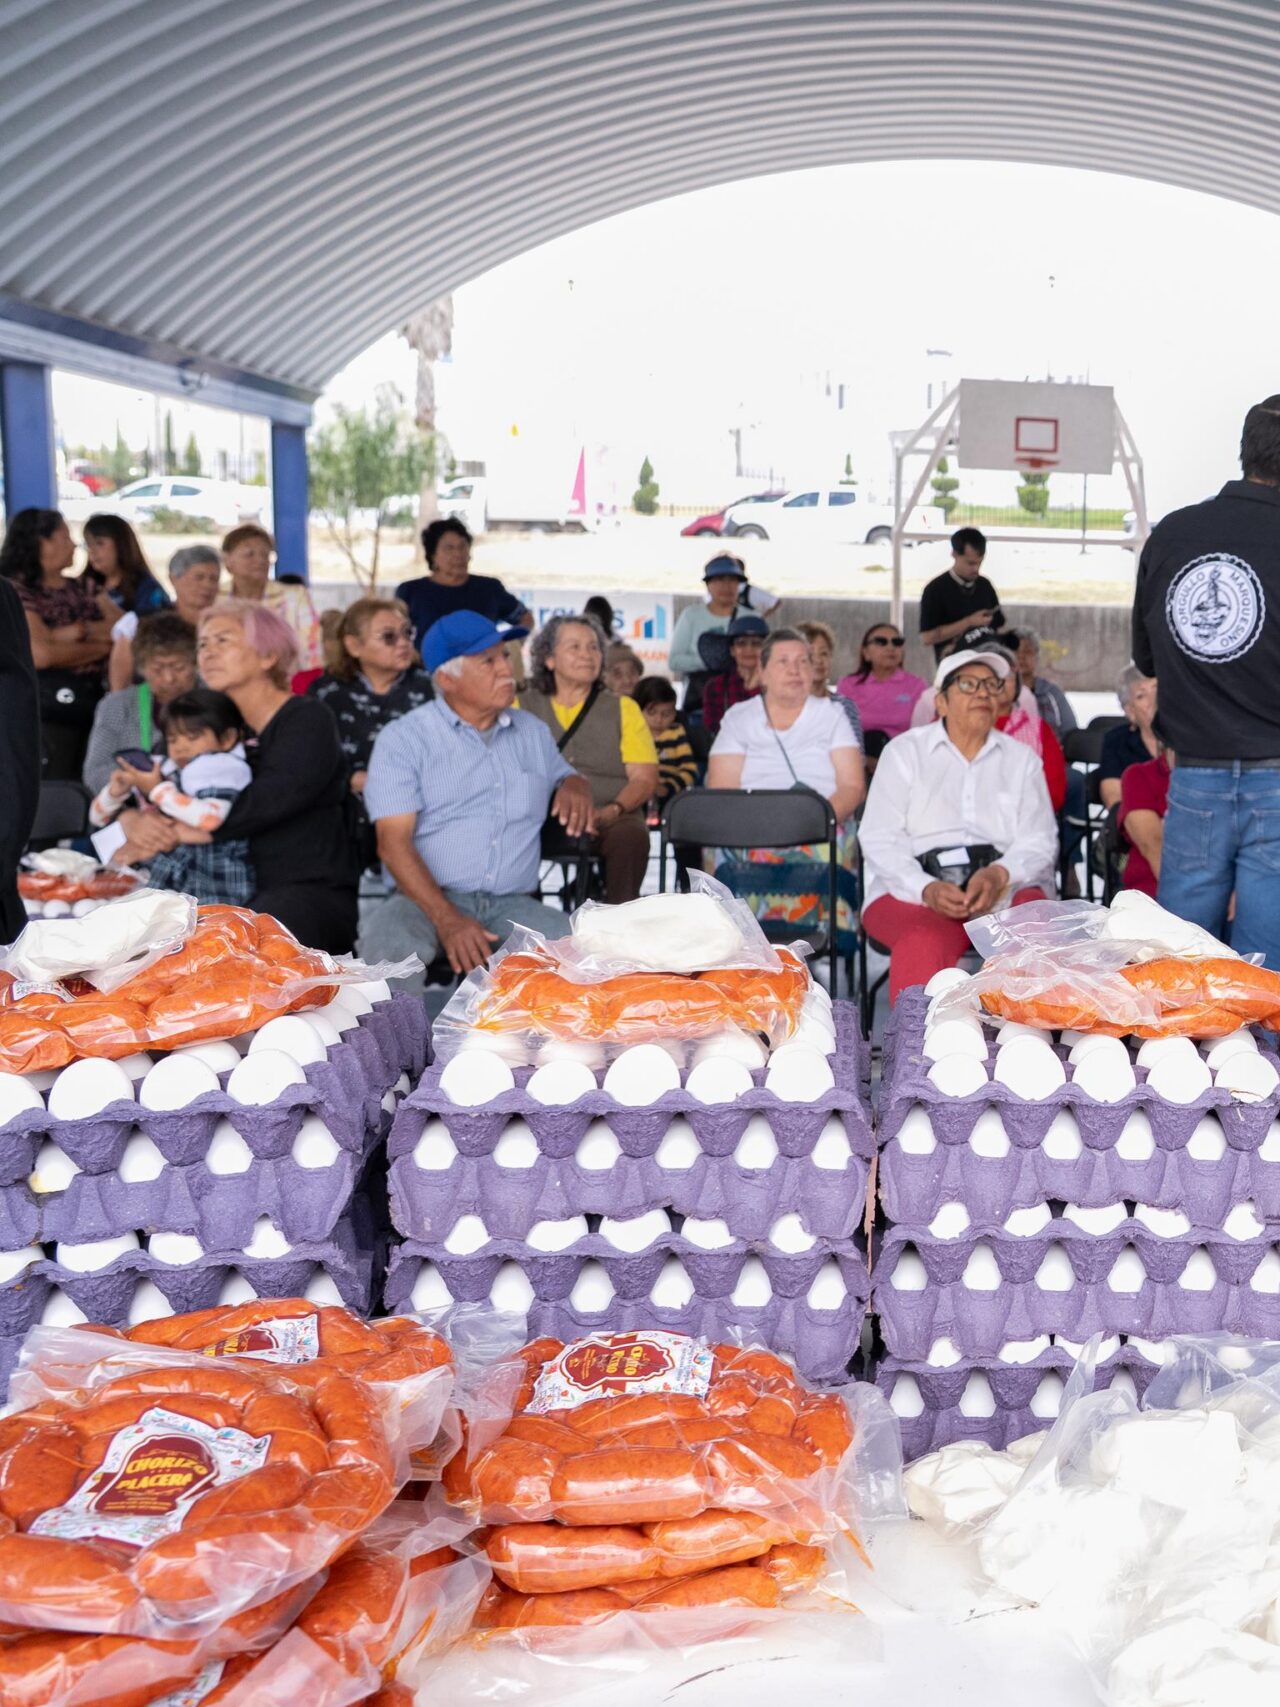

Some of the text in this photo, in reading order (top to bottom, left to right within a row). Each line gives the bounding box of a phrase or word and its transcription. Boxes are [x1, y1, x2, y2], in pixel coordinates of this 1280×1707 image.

[1178, 570, 1251, 648] ORGULLO MARQUESINO
[125, 1457, 208, 1475] CHORIZO
